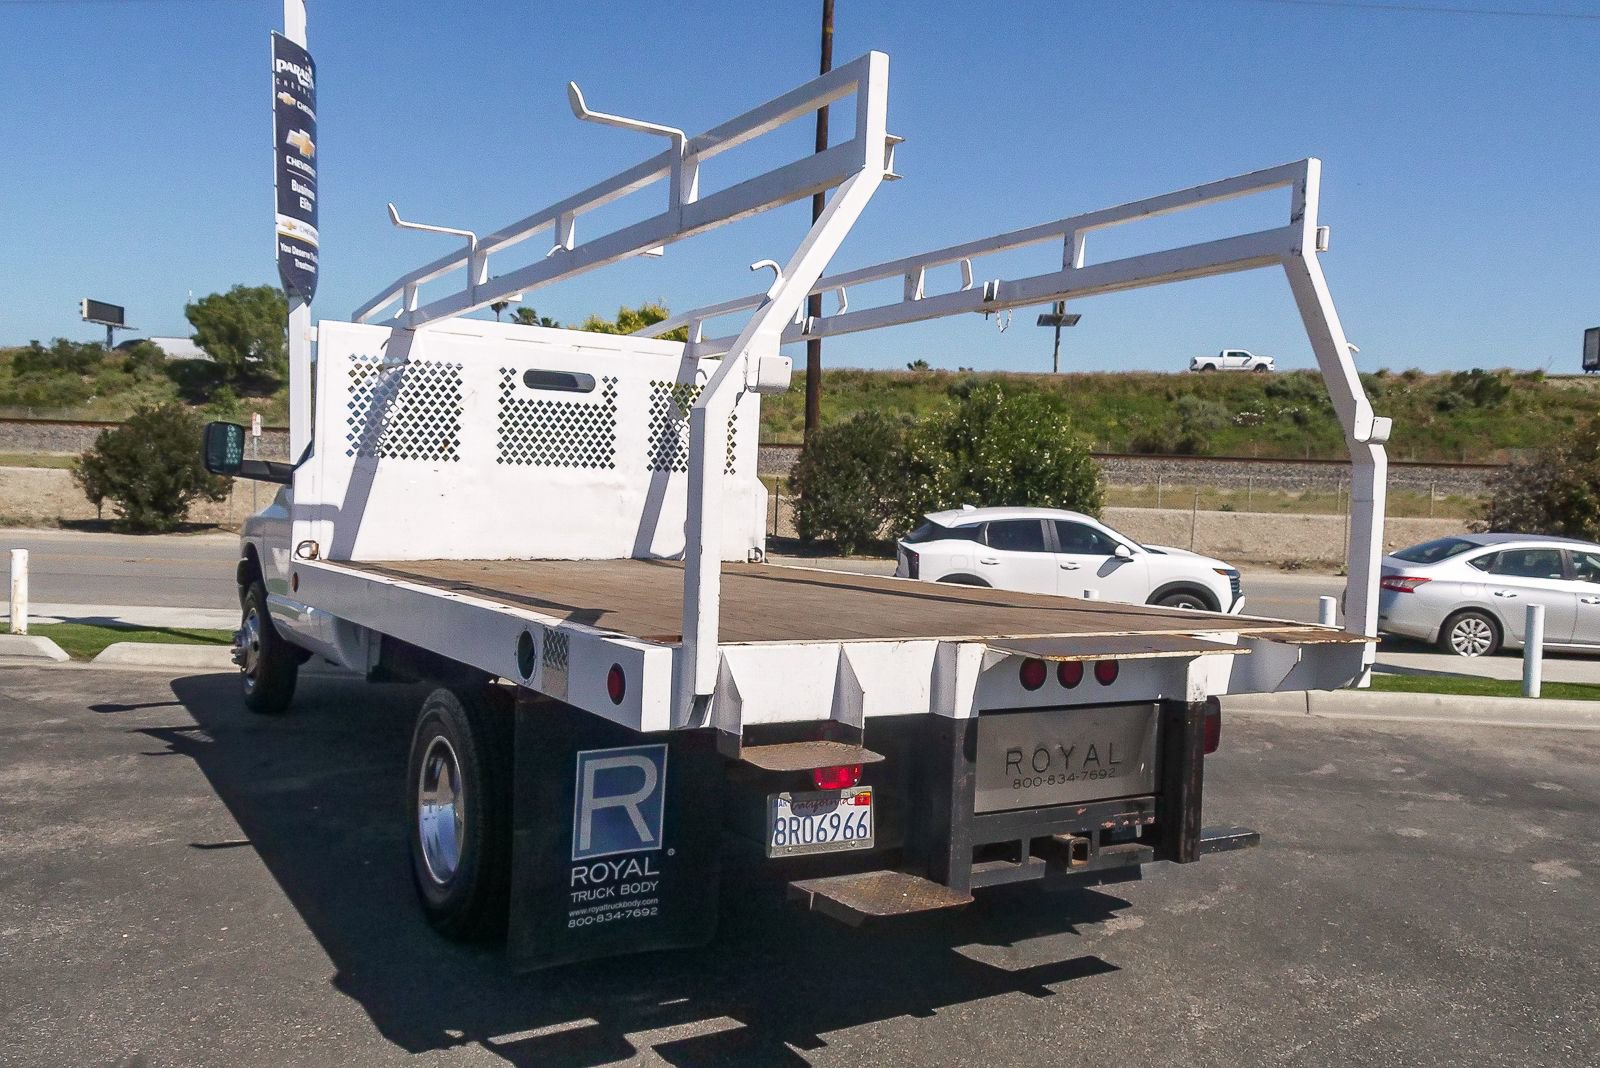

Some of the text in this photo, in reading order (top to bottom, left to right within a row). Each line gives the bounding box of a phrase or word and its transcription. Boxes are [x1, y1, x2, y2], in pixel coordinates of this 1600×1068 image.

[280, 242, 291, 254] You
[1005, 742, 1122, 776] ROYAL
[1012, 768, 1117, 790] 800-834-7692
[580, 755, 658, 850] R
[571, 856, 660, 888] ROYAL
[570, 880, 659, 903] TRUCK BODY
[568, 897, 659, 918] www.royaltruckbody.com
